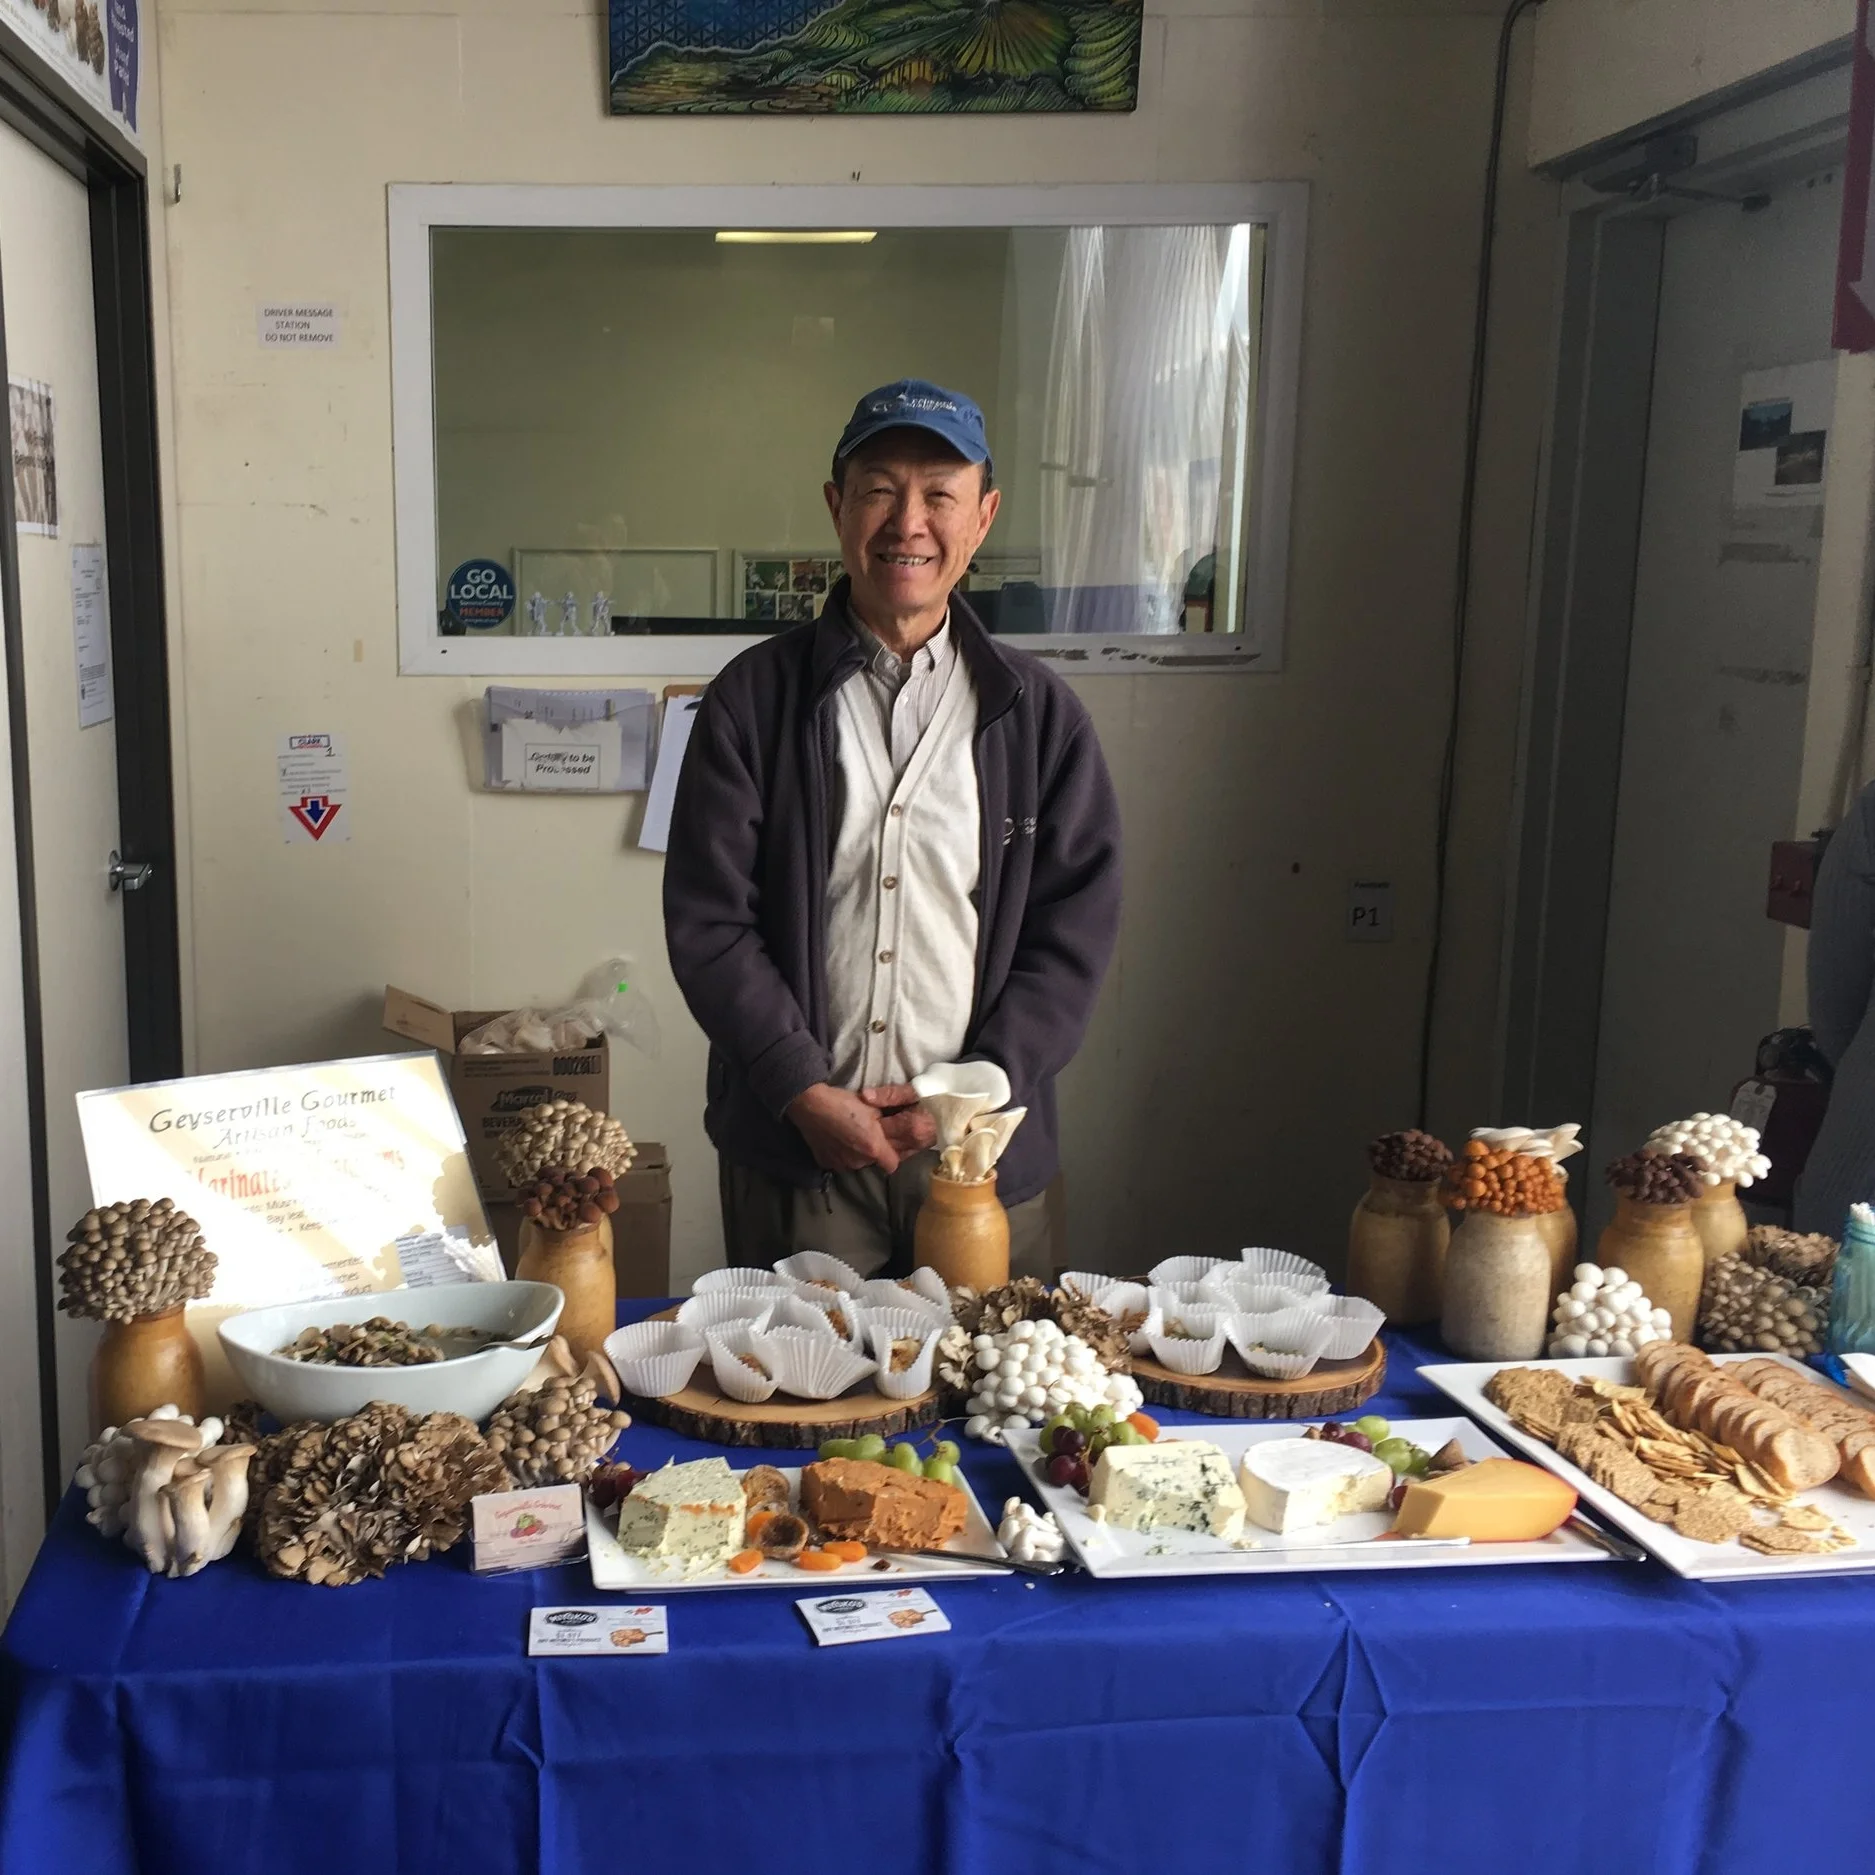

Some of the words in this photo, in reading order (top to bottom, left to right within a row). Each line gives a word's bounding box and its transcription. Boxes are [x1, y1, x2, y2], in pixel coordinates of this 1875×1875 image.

[264, 308, 293, 317] DRIVER
[295, 308, 333, 317] MESSAGE
[275, 321, 310, 330] STATION
[265, 333, 278, 342] DO
[280, 333, 297, 342] NOT
[299, 333, 333, 342] REMOVE
[466, 568, 496, 584] GO
[450, 584, 514, 600] LOCAL
[582, 752, 596, 763] be
[1352, 906, 1380, 927] P1
[149, 1096, 292, 1133] Geyserville
[300, 1085, 396, 1111] Gourmet
[212, 1123, 293, 1150] Artisan
